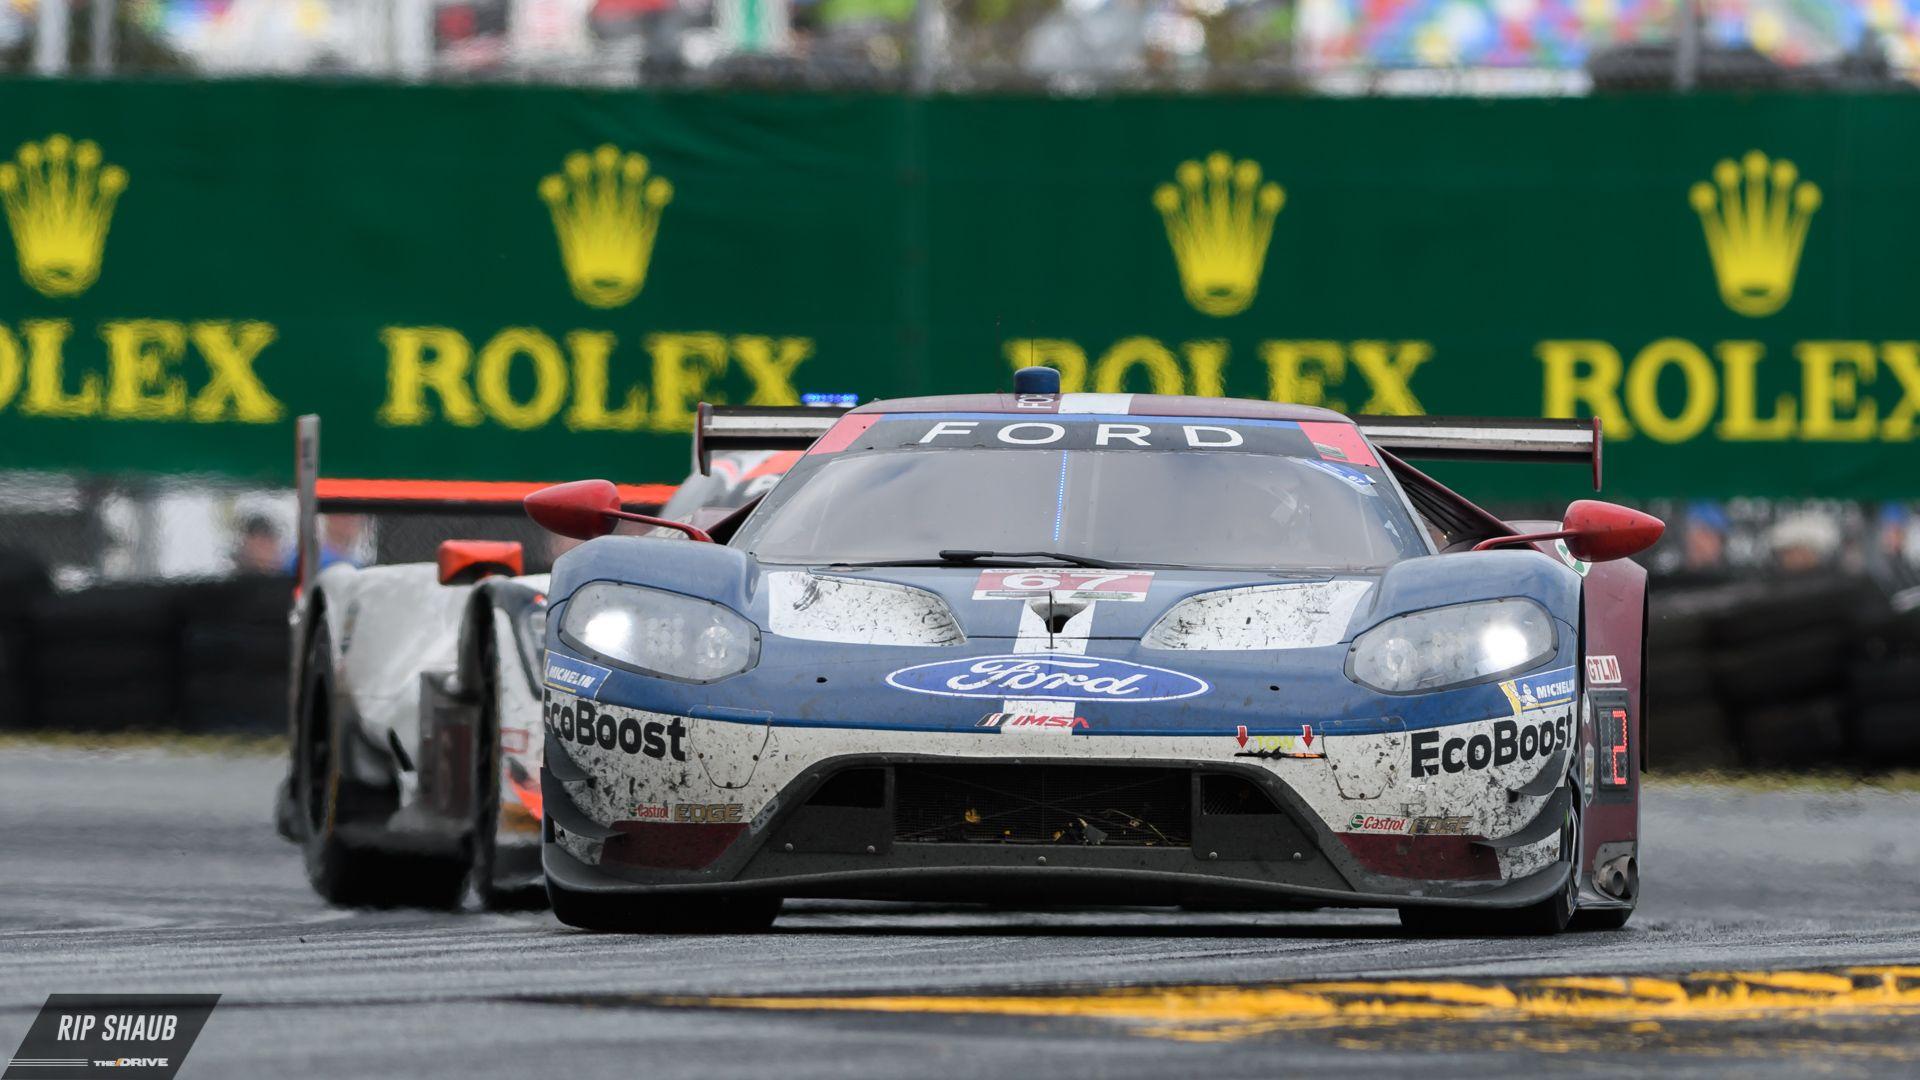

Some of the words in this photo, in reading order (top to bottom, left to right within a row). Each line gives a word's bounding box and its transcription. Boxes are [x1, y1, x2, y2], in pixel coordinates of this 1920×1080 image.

[0, 319, 284, 424] LEX
[375, 325, 816, 431] ROLEX
[919, 421, 1245, 447] FORD
[1002, 573, 1128, 591] 67
[547, 664, 597, 689] MICHELIN
[946, 659, 1148, 696] Ford
[1587, 658, 1620, 681] GTLM
[544, 688, 686, 761] EcoBoost
[1011, 715, 1090, 729] IMSA
[1410, 705, 1572, 778] EcoBoost
[636, 803, 669, 820] Castrol
[673, 803, 744, 823] EDGE
[1363, 816, 1406, 831] Castrol
